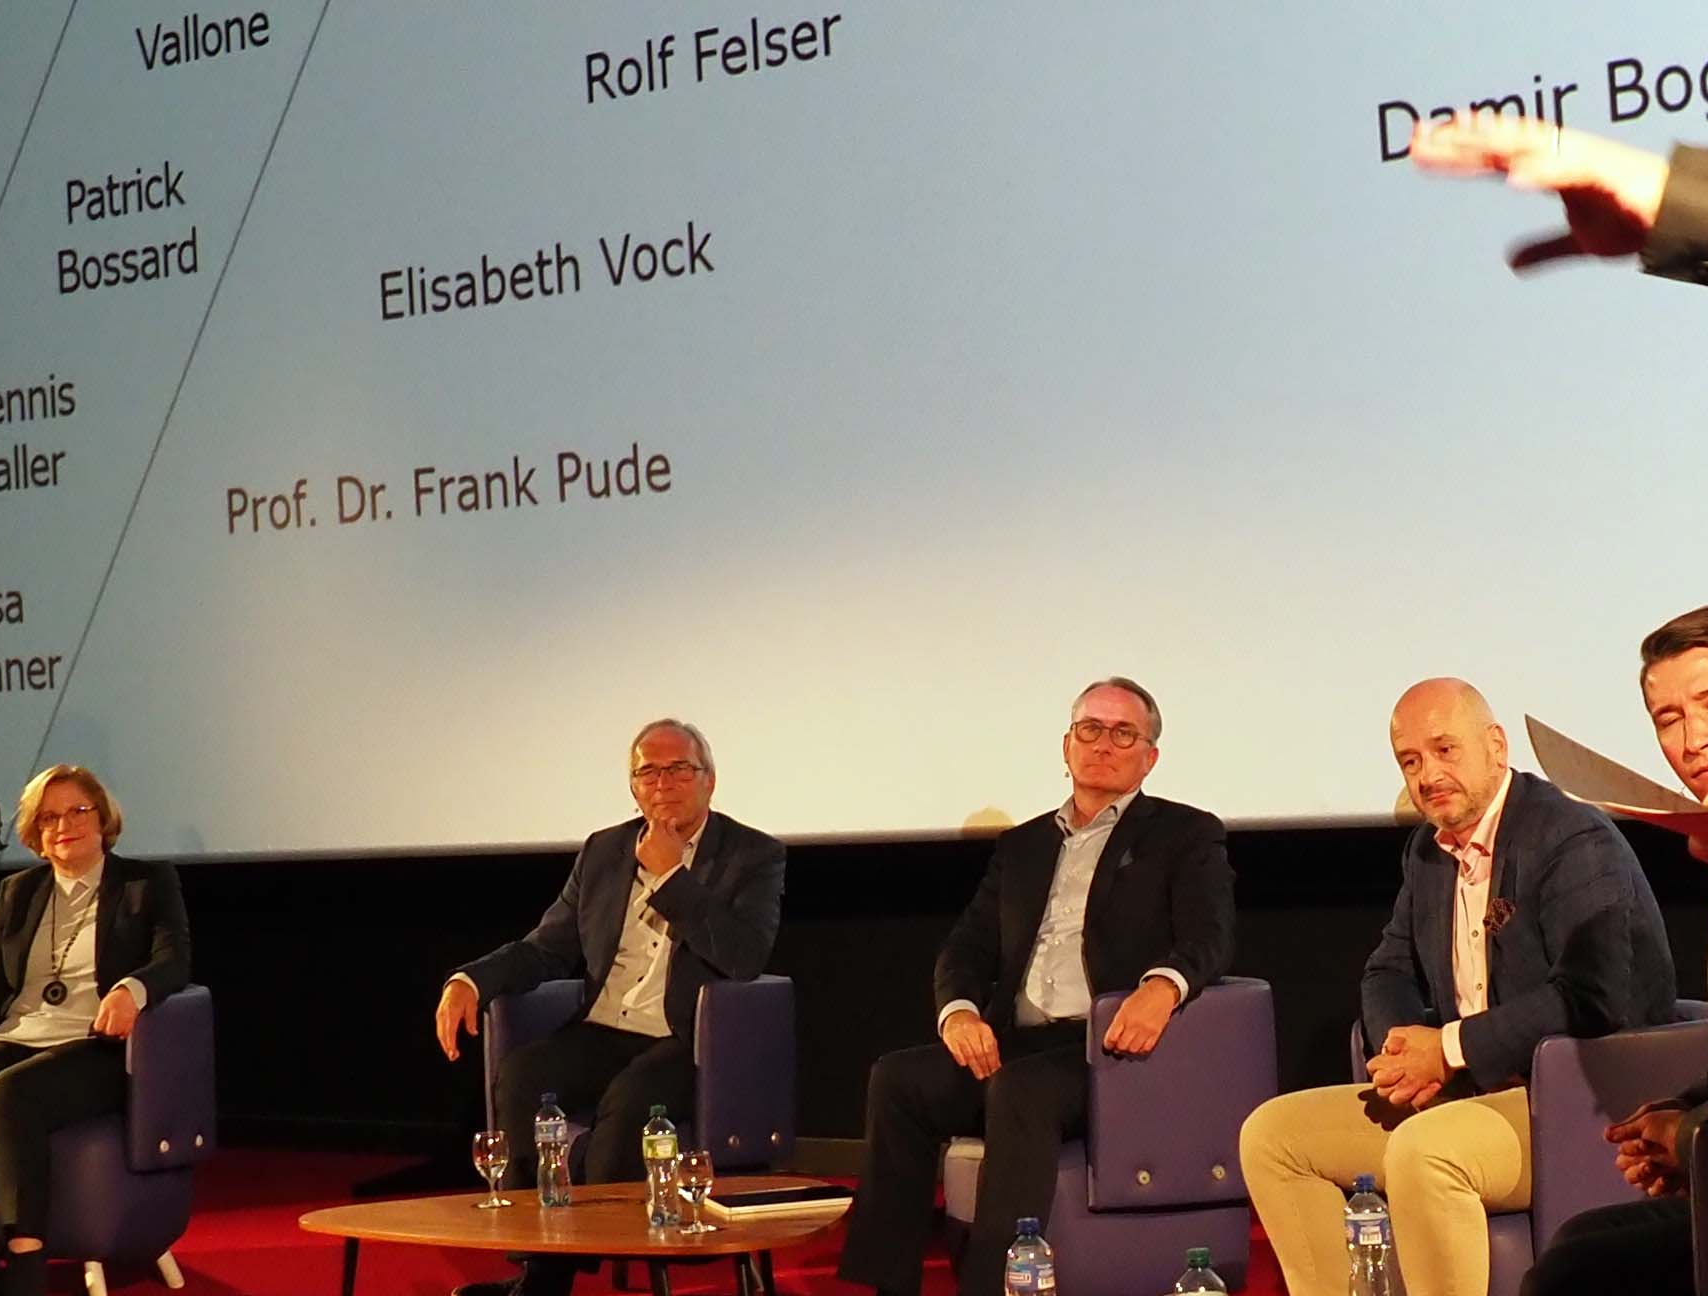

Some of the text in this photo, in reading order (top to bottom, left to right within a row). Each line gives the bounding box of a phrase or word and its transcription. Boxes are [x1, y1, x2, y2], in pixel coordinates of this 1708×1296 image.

[135, 5, 270, 71] Vallone
[585, 12, 842, 104] Rolf Felser
[66, 160, 186, 225] Patrick
[57, 225, 198, 295] Bossard
[380, 220, 715, 321] Elisabeth Vock
[226, 442, 672, 535] Prof. Dr. Frank Pude
